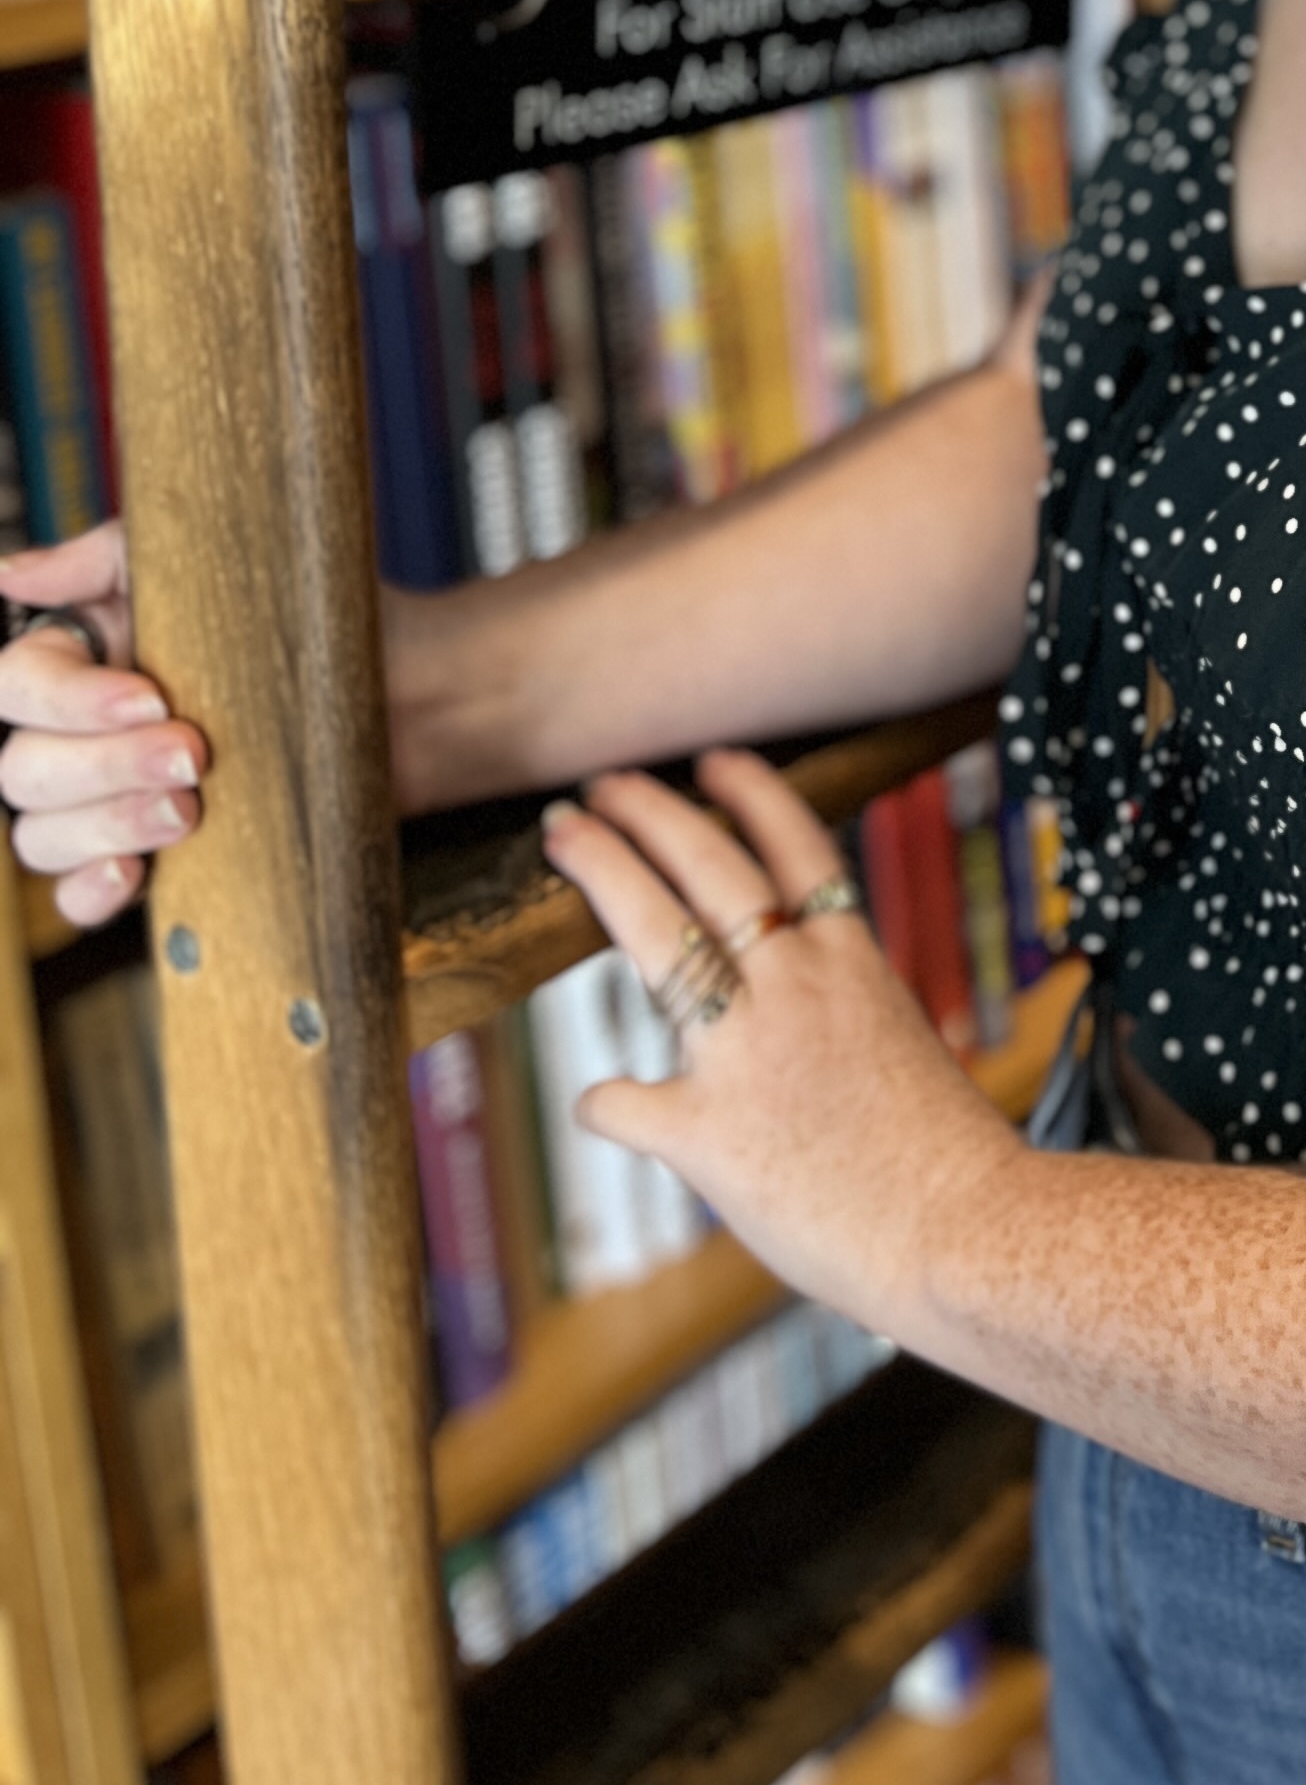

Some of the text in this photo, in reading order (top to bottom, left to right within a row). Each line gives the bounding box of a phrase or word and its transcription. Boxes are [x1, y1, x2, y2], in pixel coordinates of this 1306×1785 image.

[514, 78, 669, 151] Please
[671, 43, 757, 118] Ask
[759, 33, 832, 99] For
